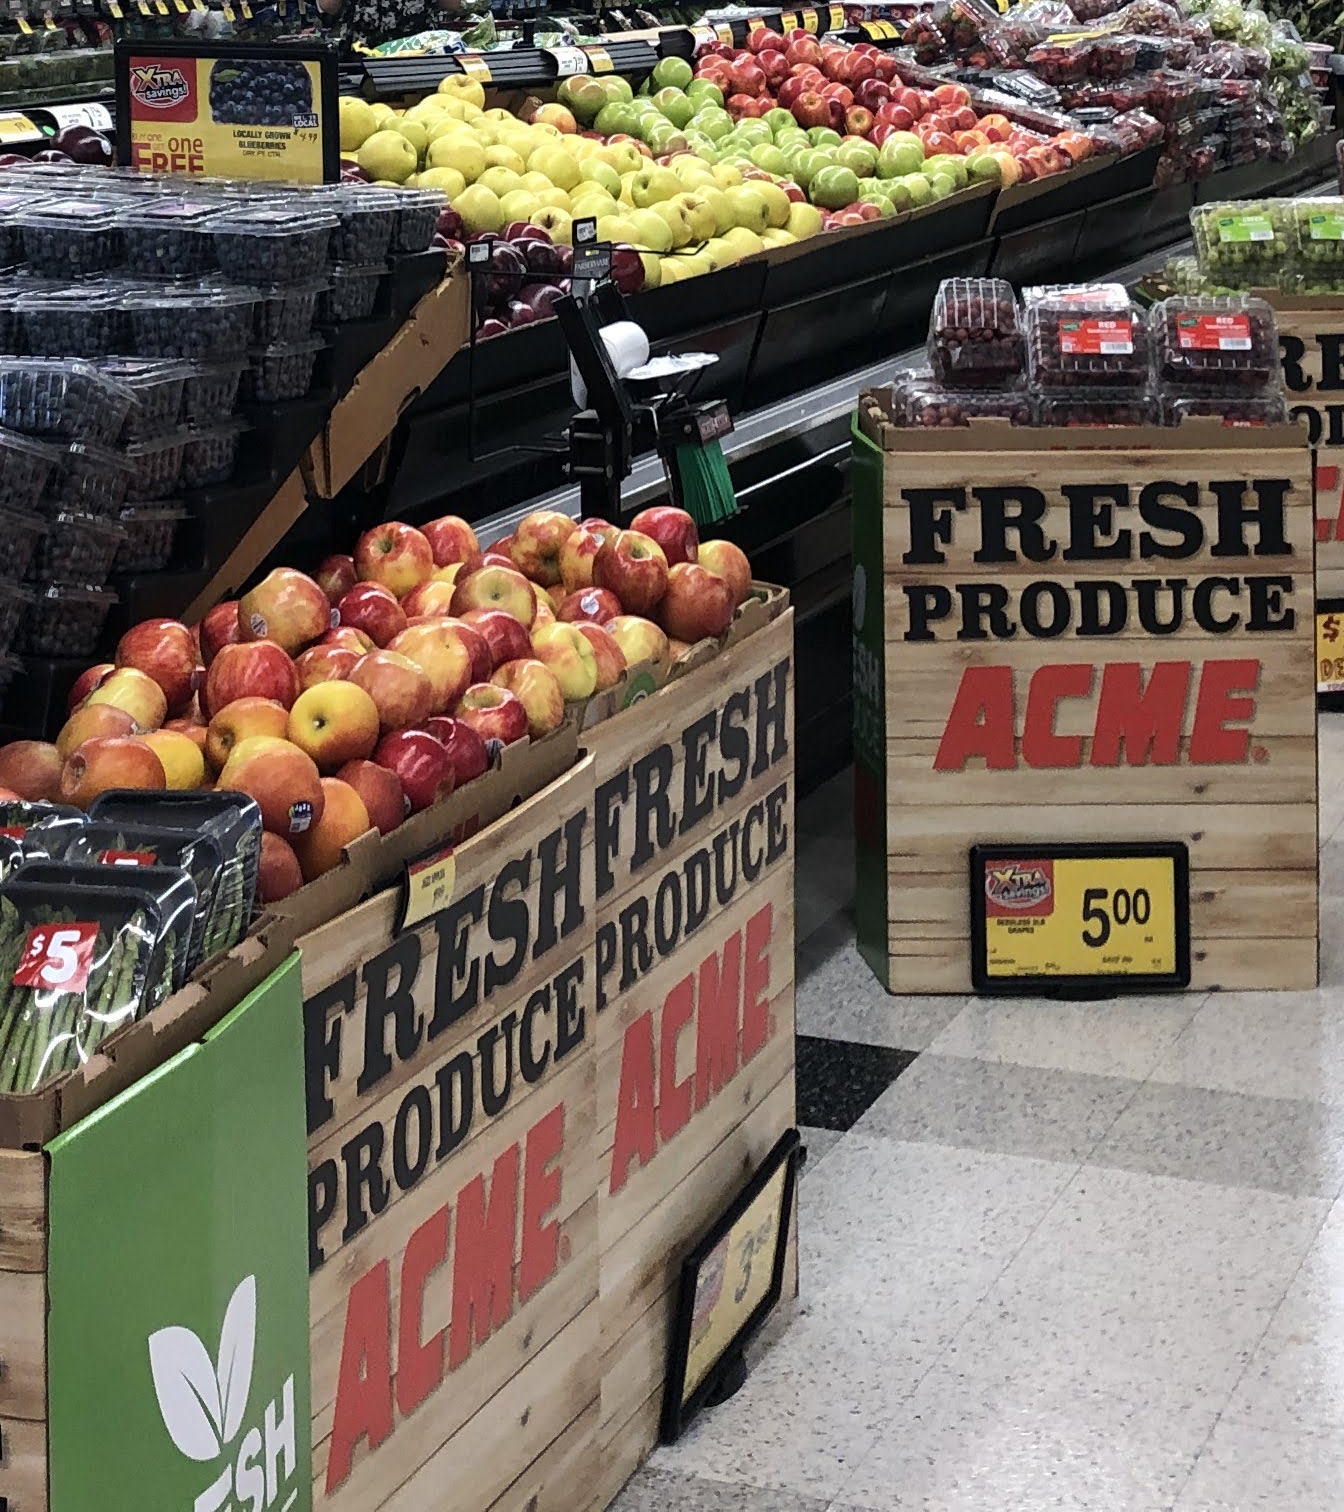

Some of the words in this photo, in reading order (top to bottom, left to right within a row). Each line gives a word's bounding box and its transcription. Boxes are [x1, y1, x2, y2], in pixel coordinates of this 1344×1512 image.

[168, 137, 203, 154] one
[233, 130, 262, 139] LOCALLY
[239, 140, 286, 150] BLUEBERRIES
[1098, 321, 1116, 329] RED
[1216, 317, 1234, 325] RED
[901, 478, 1293, 566] FRESH
[902, 575, 1297, 641] PRODUCE
[933, 658, 1261, 772] ACME
[595, 656, 790, 898] FRESH
[596, 781, 789, 1011] PRODUCE
[30, 927, 82, 984] $5
[303, 805, 589, 1136] FRESH
[609, 903, 774, 1196] ACME
[308, 954, 588, 1275] PRODUCE
[326, 1102, 565, 1496] ACME
